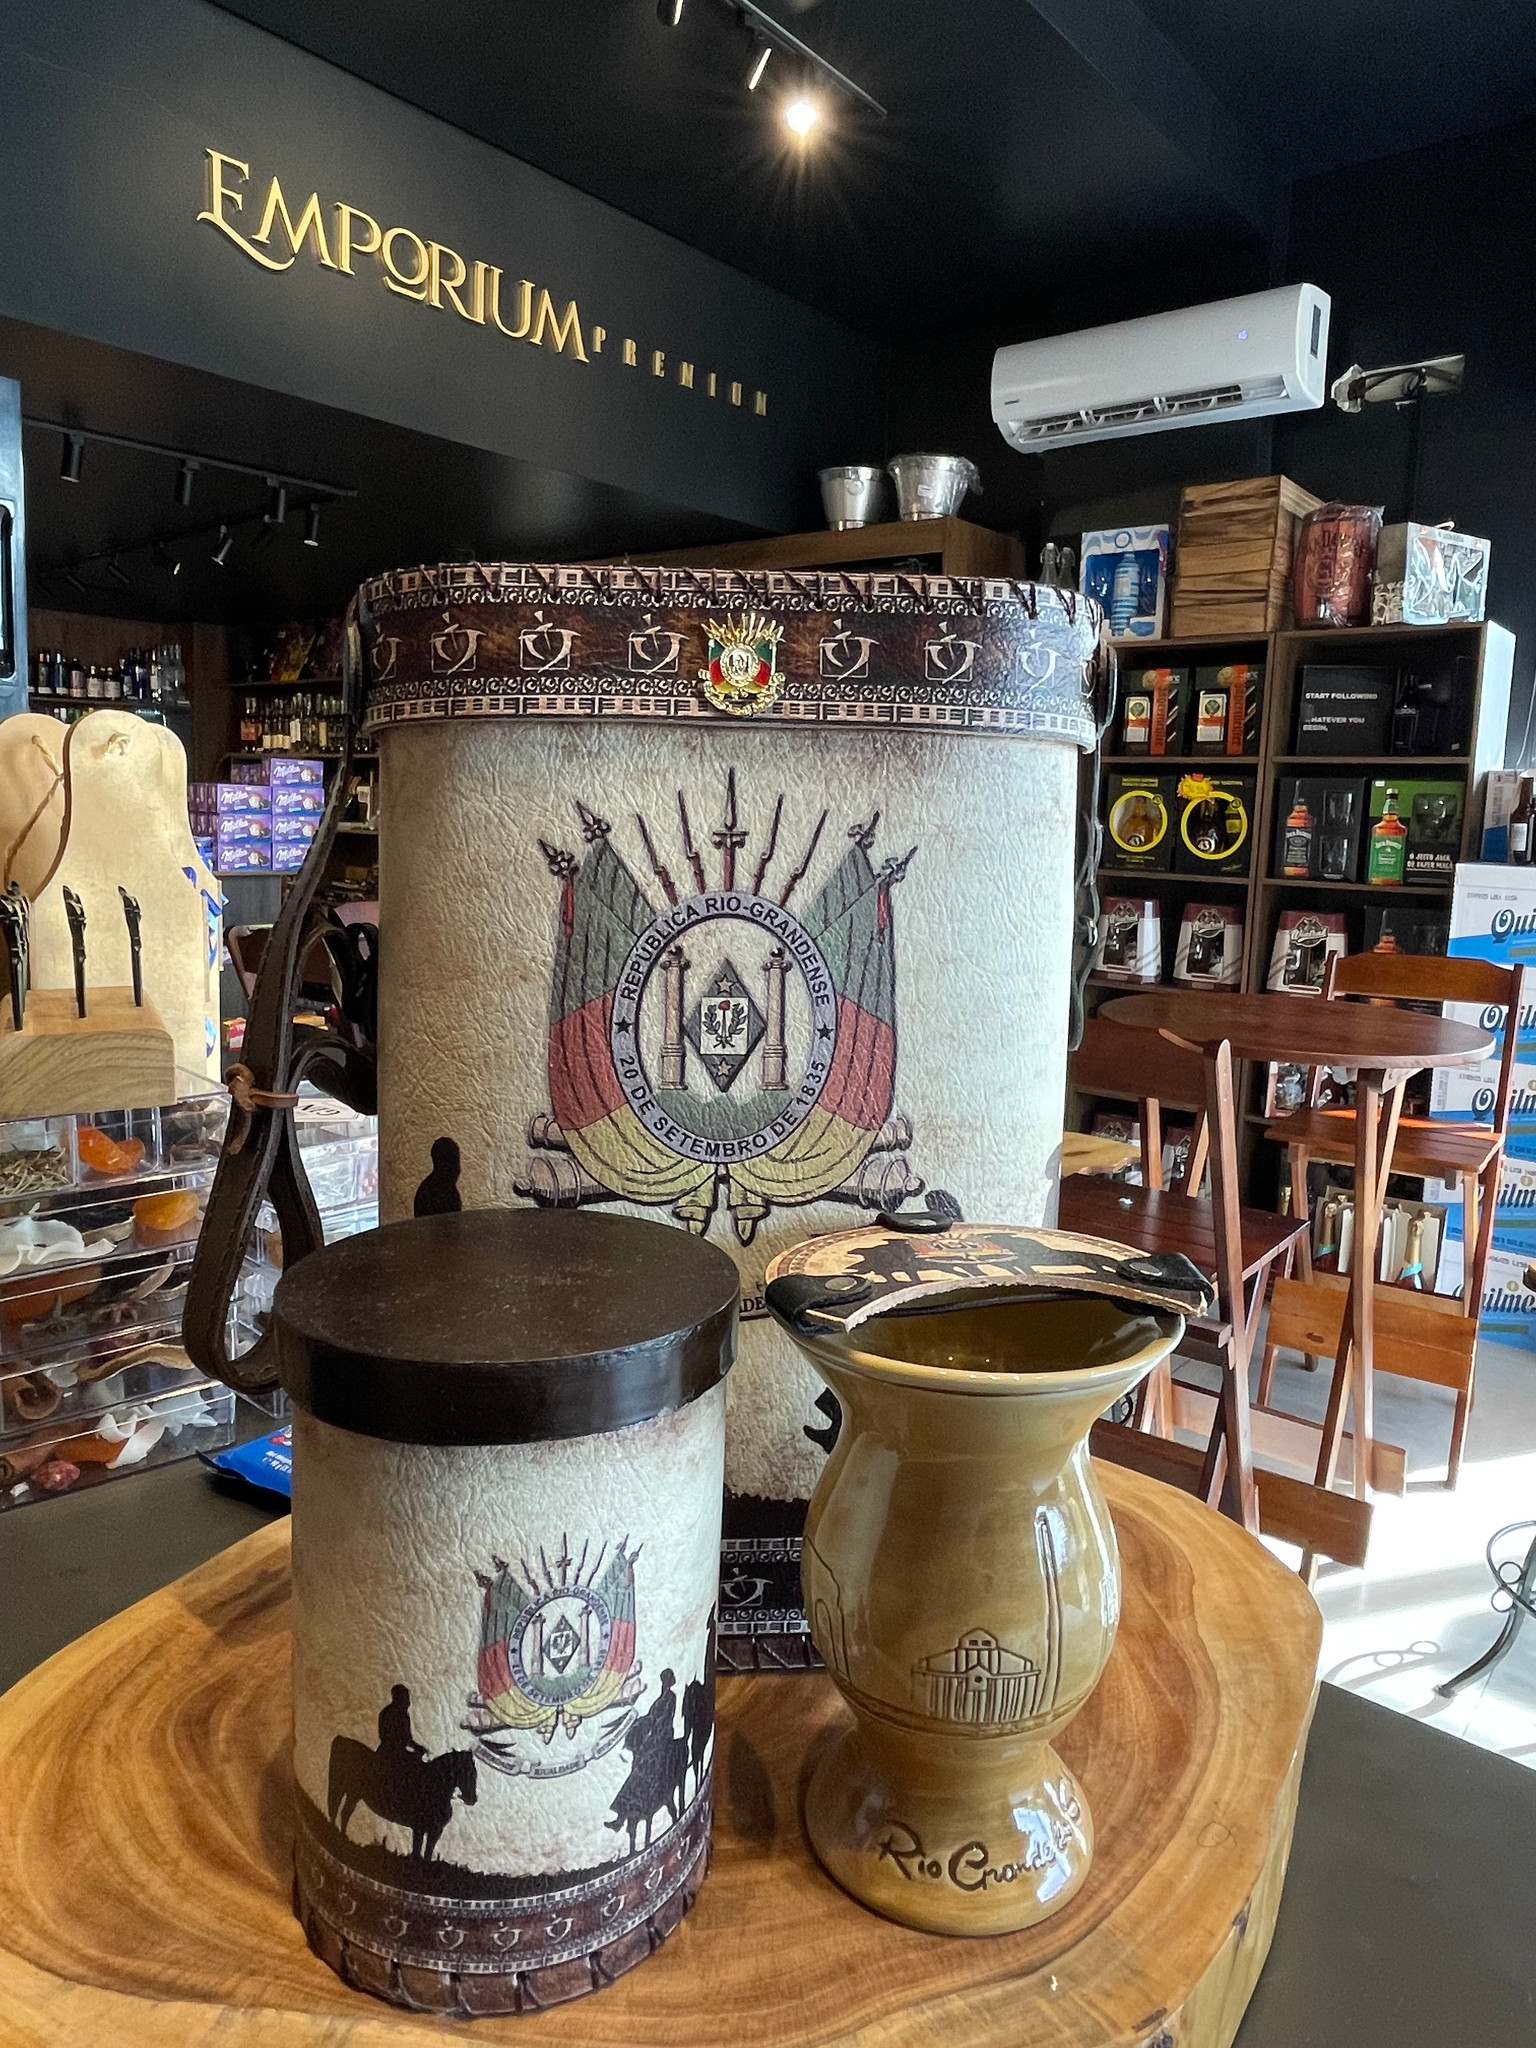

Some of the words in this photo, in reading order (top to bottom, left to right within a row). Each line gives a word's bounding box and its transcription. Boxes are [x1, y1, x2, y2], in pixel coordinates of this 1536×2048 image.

[196, 147, 590, 364] EMPORIUM
[274, 764, 301, 778] Milka
[221, 791, 249, 805] Milka
[275, 794, 303, 807] Milka
[220, 819, 249, 833] Milka
[275, 820, 302, 834] Milka
[1197, 840, 1210, 850] 43
[220, 847, 248, 863] Milka
[275, 847, 303, 862] Milka
[619, 1055, 638, 1080] 20
[630, 1087, 656, 1116] DE
[653, 1115, 767, 1158] SETEMBRO
[770, 1110, 799, 1137] DE
[796, 1060, 826, 1107] 1835
[878, 1819, 943, 1881] Rio
